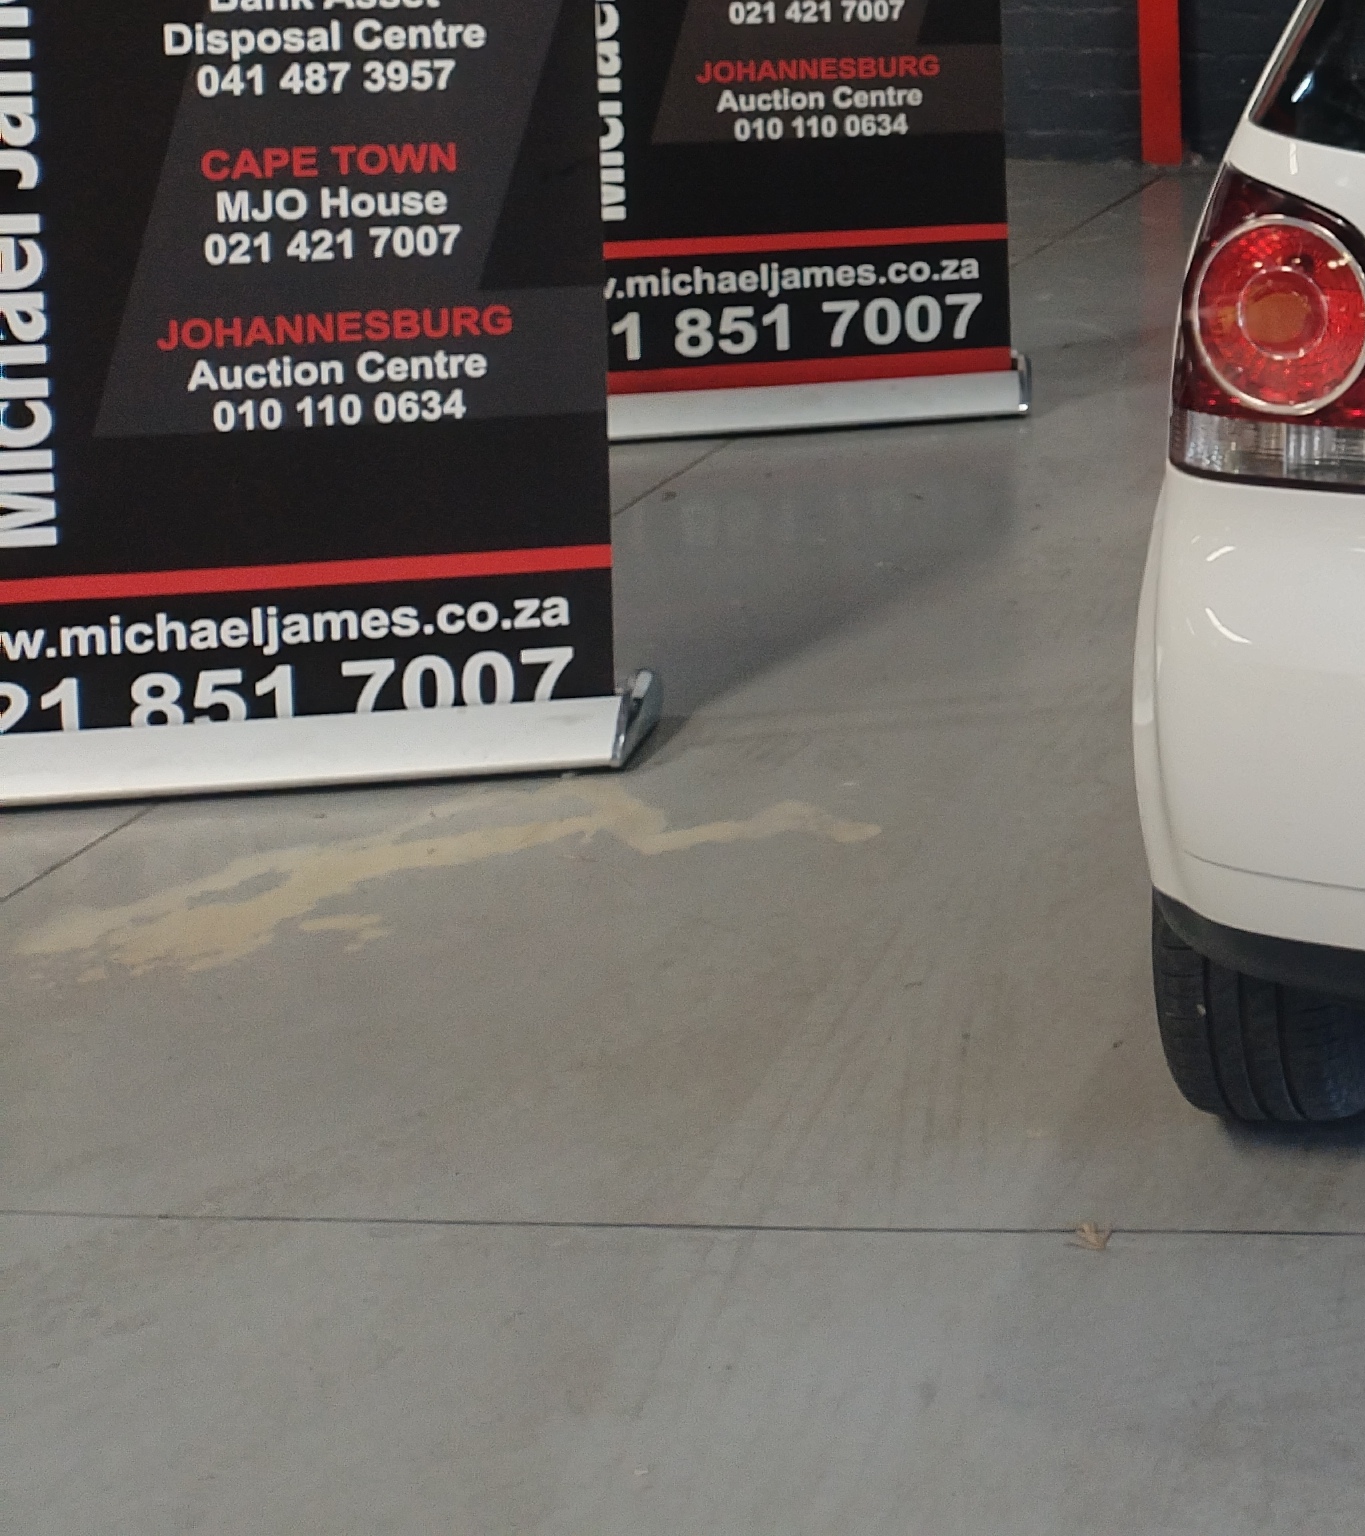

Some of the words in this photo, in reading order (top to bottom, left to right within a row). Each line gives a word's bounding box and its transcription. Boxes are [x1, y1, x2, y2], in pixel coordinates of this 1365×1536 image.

[728, 0, 776, 25] 021
[784, 0, 832, 24] 421
[163, 19, 341, 62] Disposal
[353, 18, 487, 51] Centre
[196, 63, 264, 98] 041
[279, 61, 352, 95] 487
[363, 58, 456, 93] 3957
[695, 53, 941, 85] JOHANNESBURG
[716, 87, 826, 113] Auction
[832, 85, 923, 110] Centre
[733, 116, 784, 142] 010
[791, 114, 838, 139] 110
[843, 112, 909, 138] 0634
[200, 145, 319, 182] CAPE
[329, 141, 458, 176] TOWN
[216, 188, 309, 223] MJO
[320, 185, 448, 219] House
[204, 231, 271, 266] 021
[286, 227, 353, 262] 421
[368, 223, 462, 259] 7007
[156, 304, 513, 351] JOHANNESBURG
[674, 303, 791, 358] 851
[821, 292, 983, 348] 7007
[187, 355, 345, 392] Auction
[356, 349, 488, 383] Centre
[212, 397, 283, 433] 010
[296, 393, 363, 428] 110
[373, 388, 467, 424] 0634
